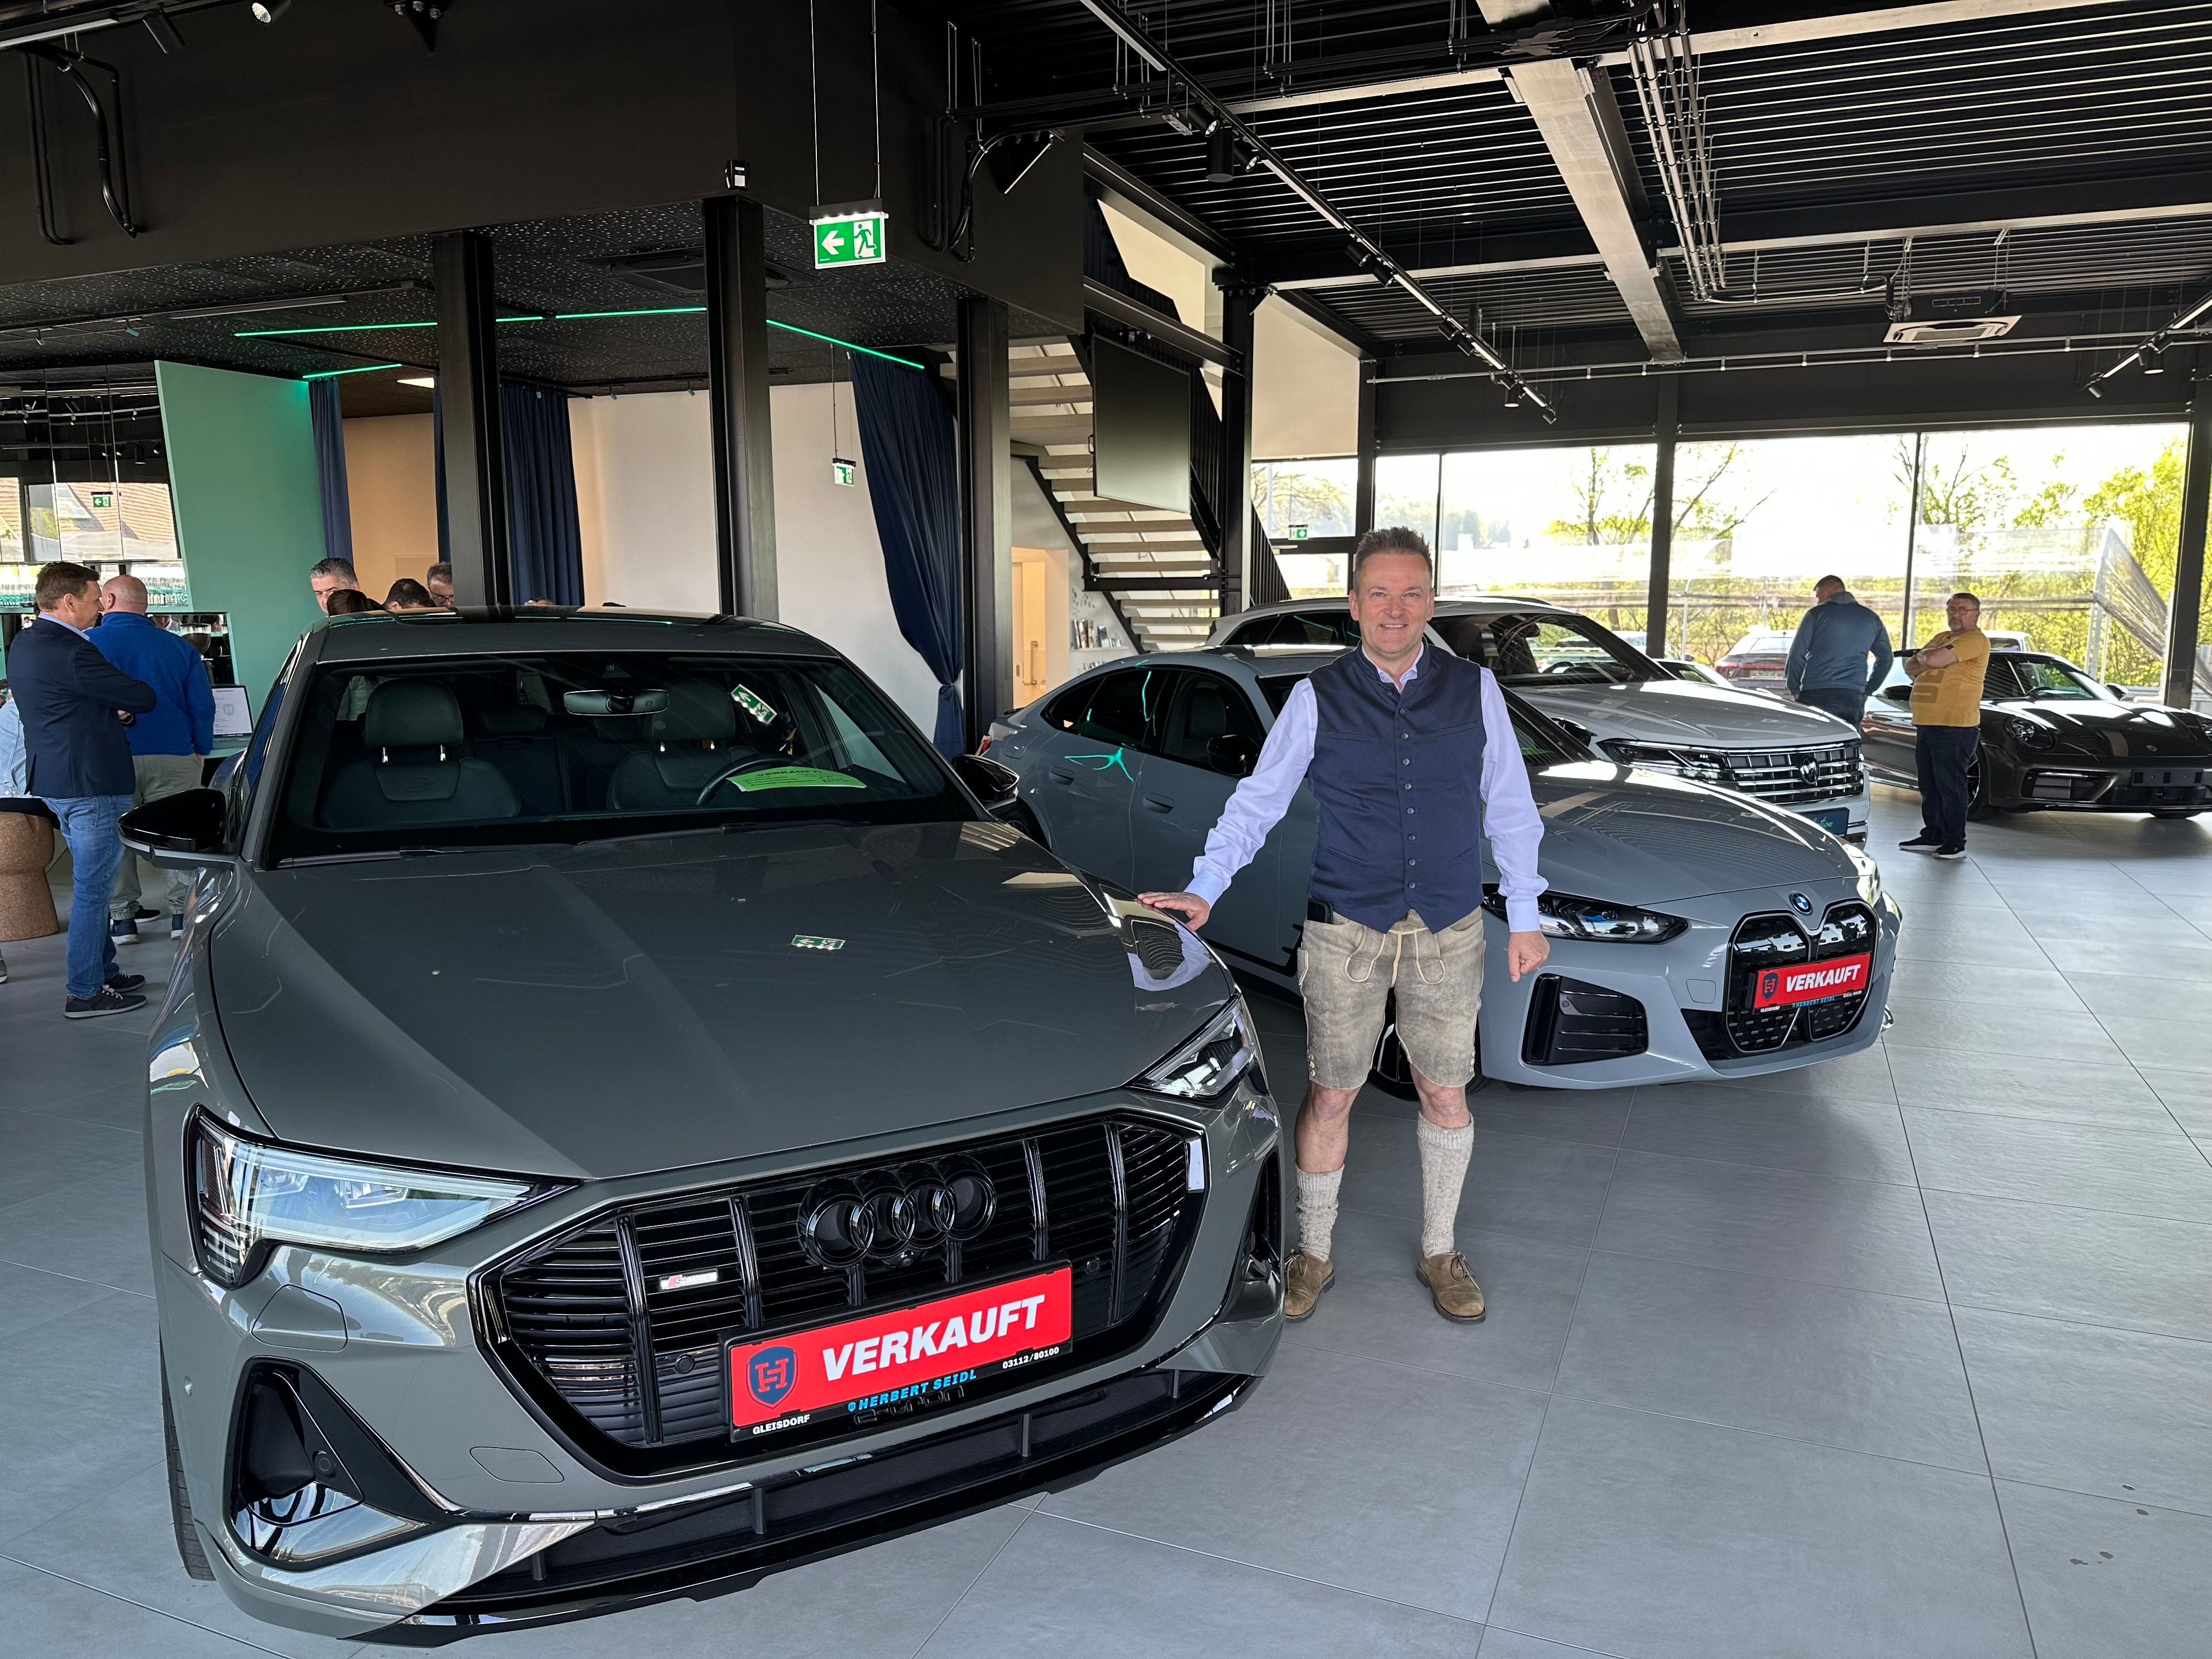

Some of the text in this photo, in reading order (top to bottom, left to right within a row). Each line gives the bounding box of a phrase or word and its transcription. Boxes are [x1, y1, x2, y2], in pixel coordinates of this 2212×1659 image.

[1786, 964, 1861, 992] VERKAUFT
[822, 1294, 1046, 1381] VERKAUFT
[1002, 1346, 1059, 1369] 03112/80100
[859, 1369, 977, 1410] HERBERT SEIDL
[752, 1414, 810, 1435] GLEISDORF
